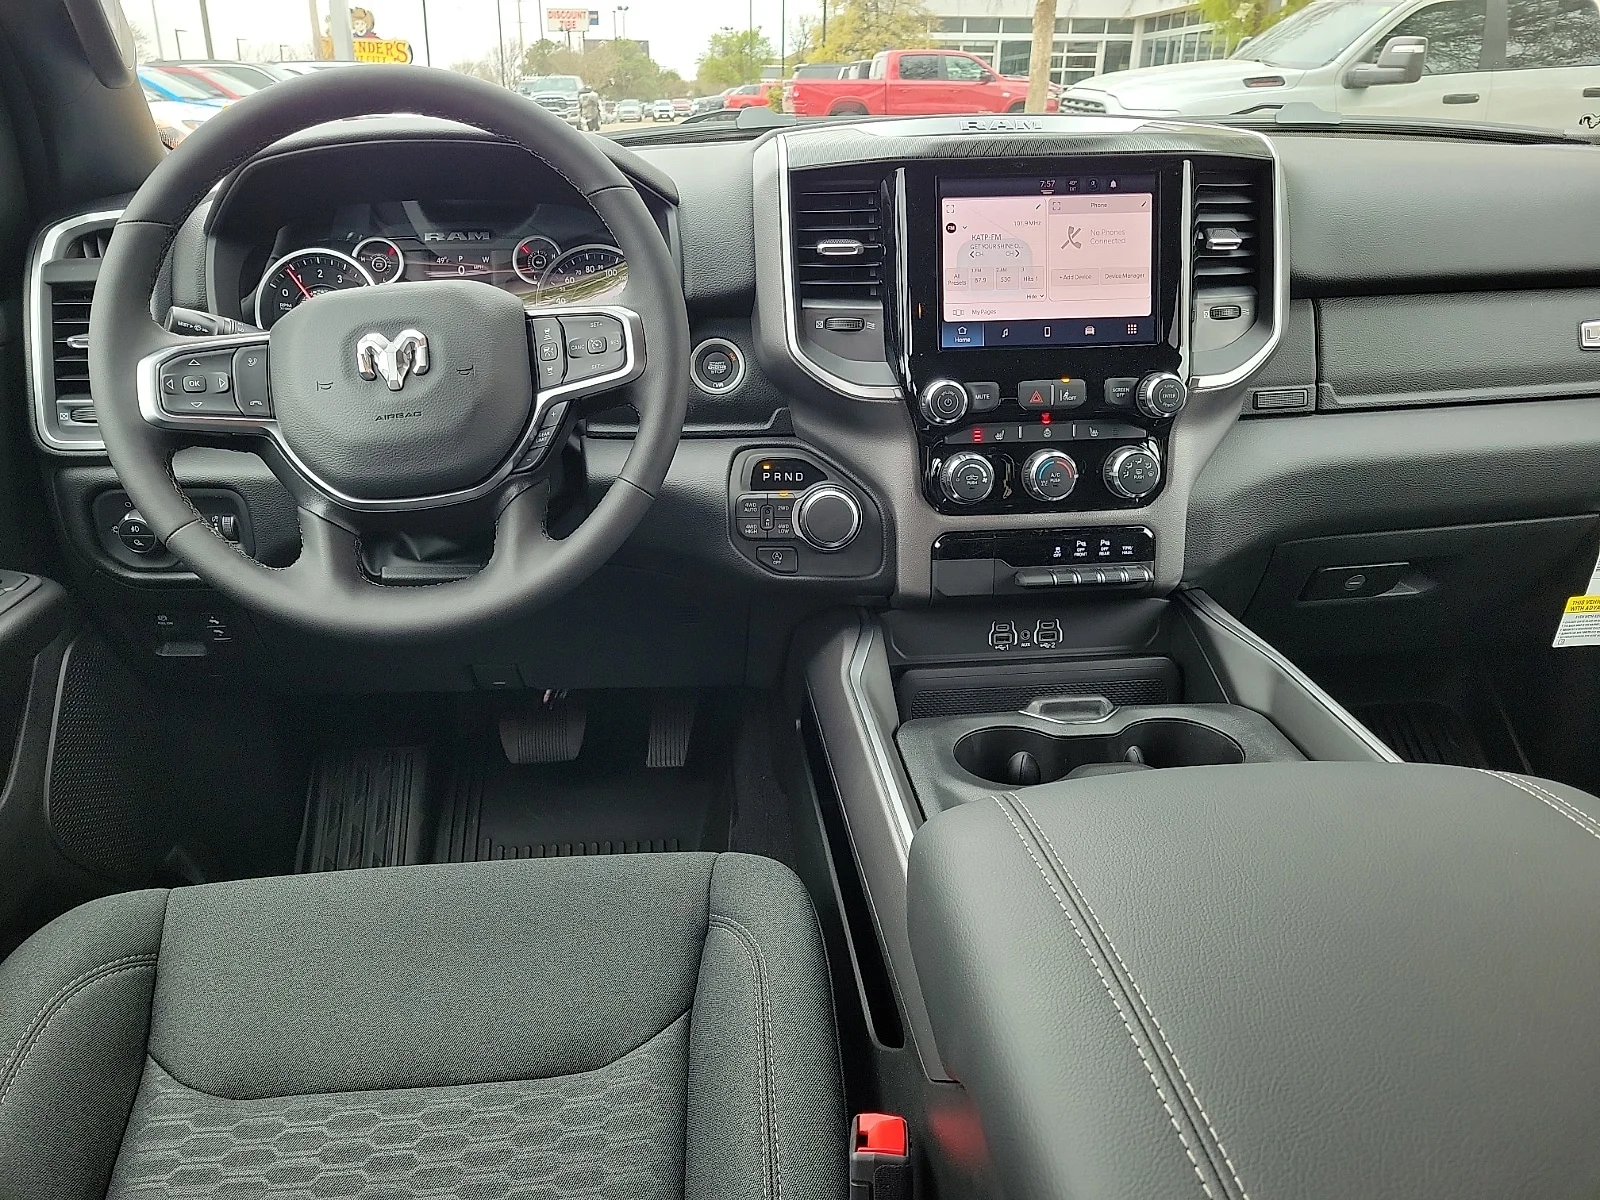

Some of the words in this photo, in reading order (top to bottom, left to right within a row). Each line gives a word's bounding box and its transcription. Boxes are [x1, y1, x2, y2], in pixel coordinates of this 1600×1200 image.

[548, 10, 586, 19] DISCOUNT
[353, 40, 408, 63] NDER'S
[959, 119, 1043, 131] RAM
[1040, 180, 1055, 188] 7:57
[424, 231, 490, 242] RAM
[971, 233, 1002, 241] KATP-FM
[317, 269, 324, 278] 2
[458, 265, 465, 275] 0
[585, 265, 595, 274] 80
[605, 270, 618, 278] 100
[337, 274, 343, 283] 3
[565, 276, 575, 284] 60
[281, 288, 289, 297] 0
[556, 296, 566, 304] 40
[188, 380, 201, 388] OK
[375, 411, 422, 421] AIRBAG
